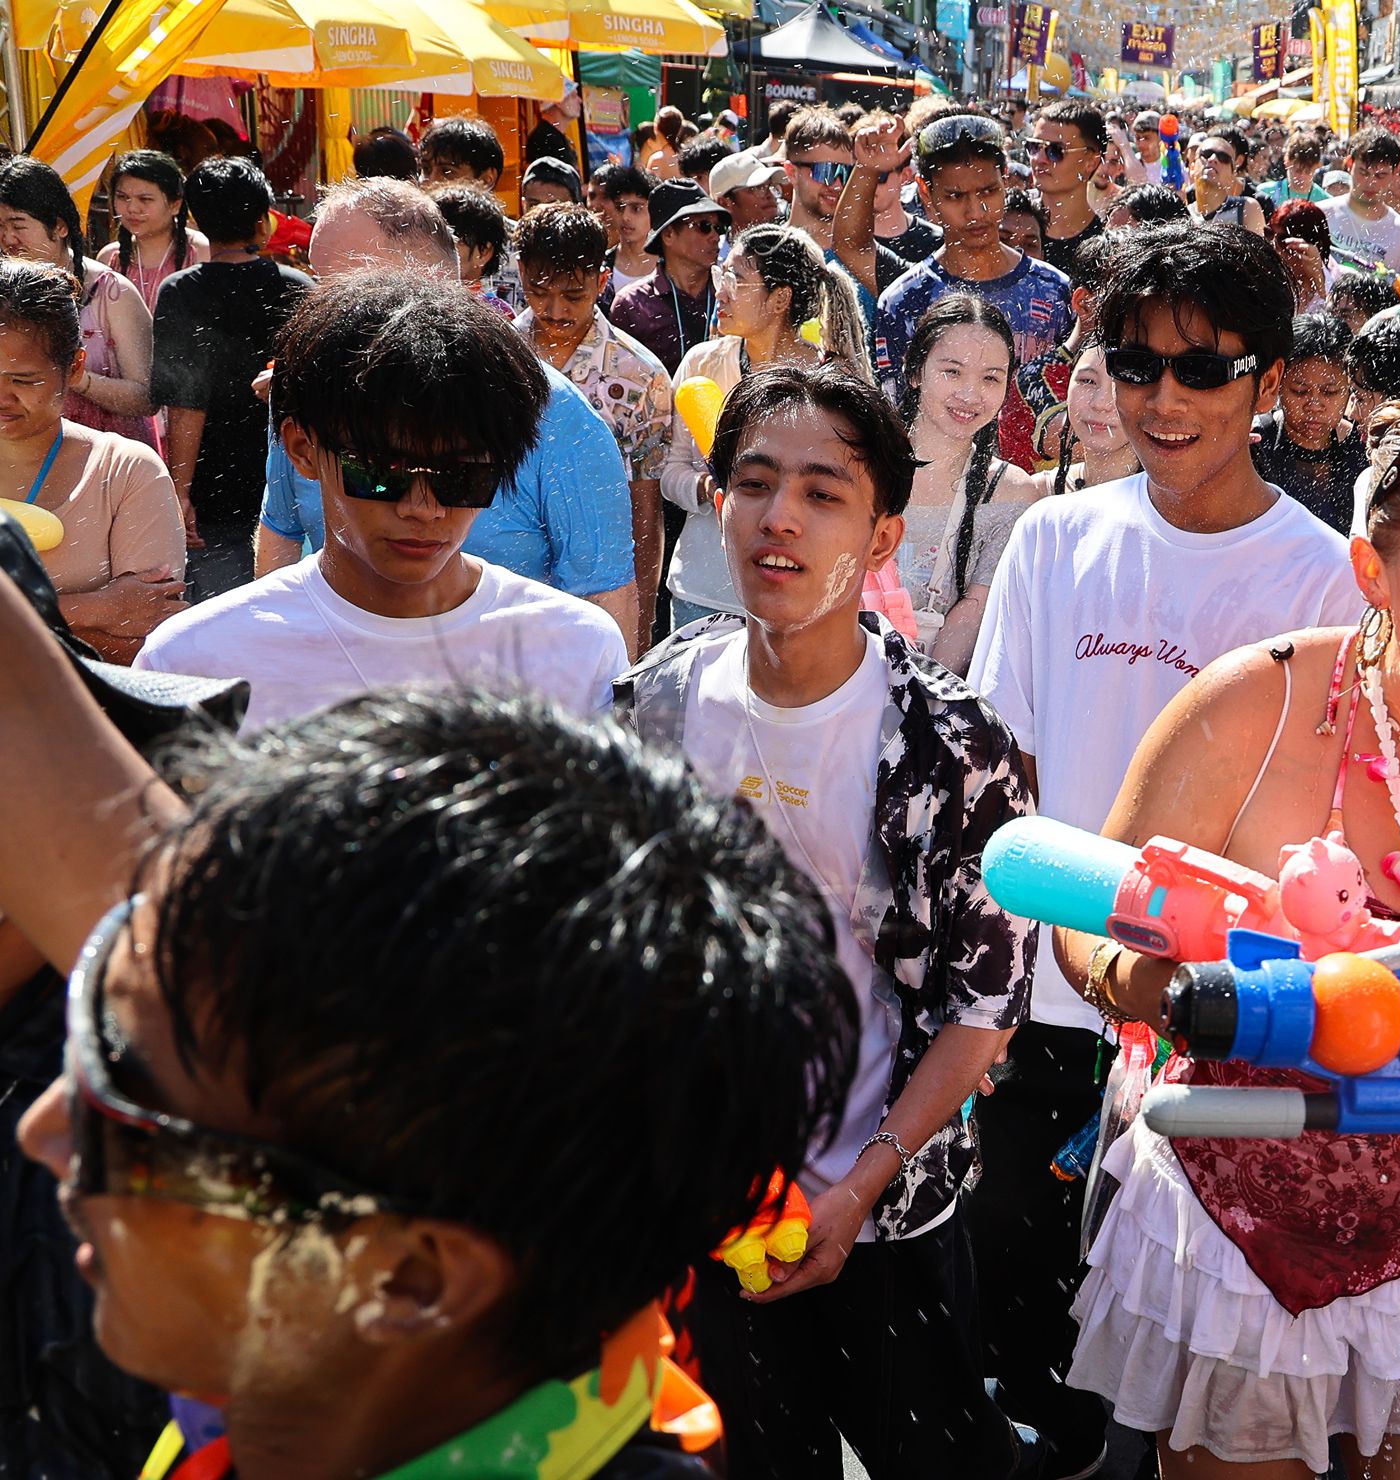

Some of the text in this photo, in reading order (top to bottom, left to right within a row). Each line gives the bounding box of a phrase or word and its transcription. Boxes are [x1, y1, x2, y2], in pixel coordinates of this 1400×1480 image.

[603, 14, 665, 36] SINGHA
[328, 26, 377, 46] SINGHA
[489, 61, 534, 81] SINGHA
[765, 83, 817, 101] BOUNCE
[1075, 632, 1153, 665] Always
[776, 780, 808, 799] Soccer
